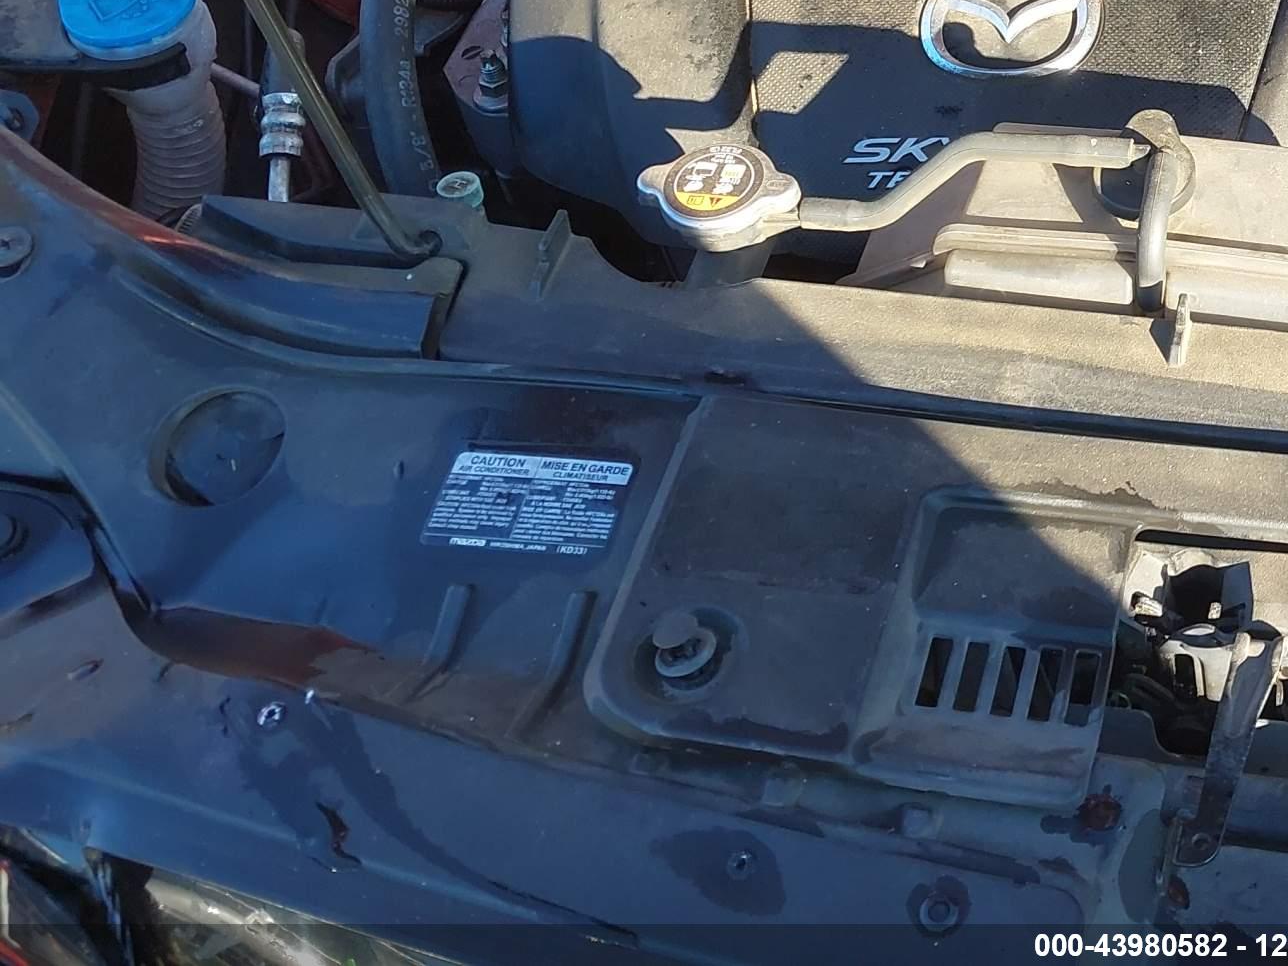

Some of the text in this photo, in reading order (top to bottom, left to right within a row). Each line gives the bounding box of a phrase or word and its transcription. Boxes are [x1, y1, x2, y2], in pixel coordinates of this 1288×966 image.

[471, 455, 526, 468] CAUTION
[458, 465, 530, 476] AIR CONDITIONER
[541, 461, 630, 476] MISE EN GARDE
